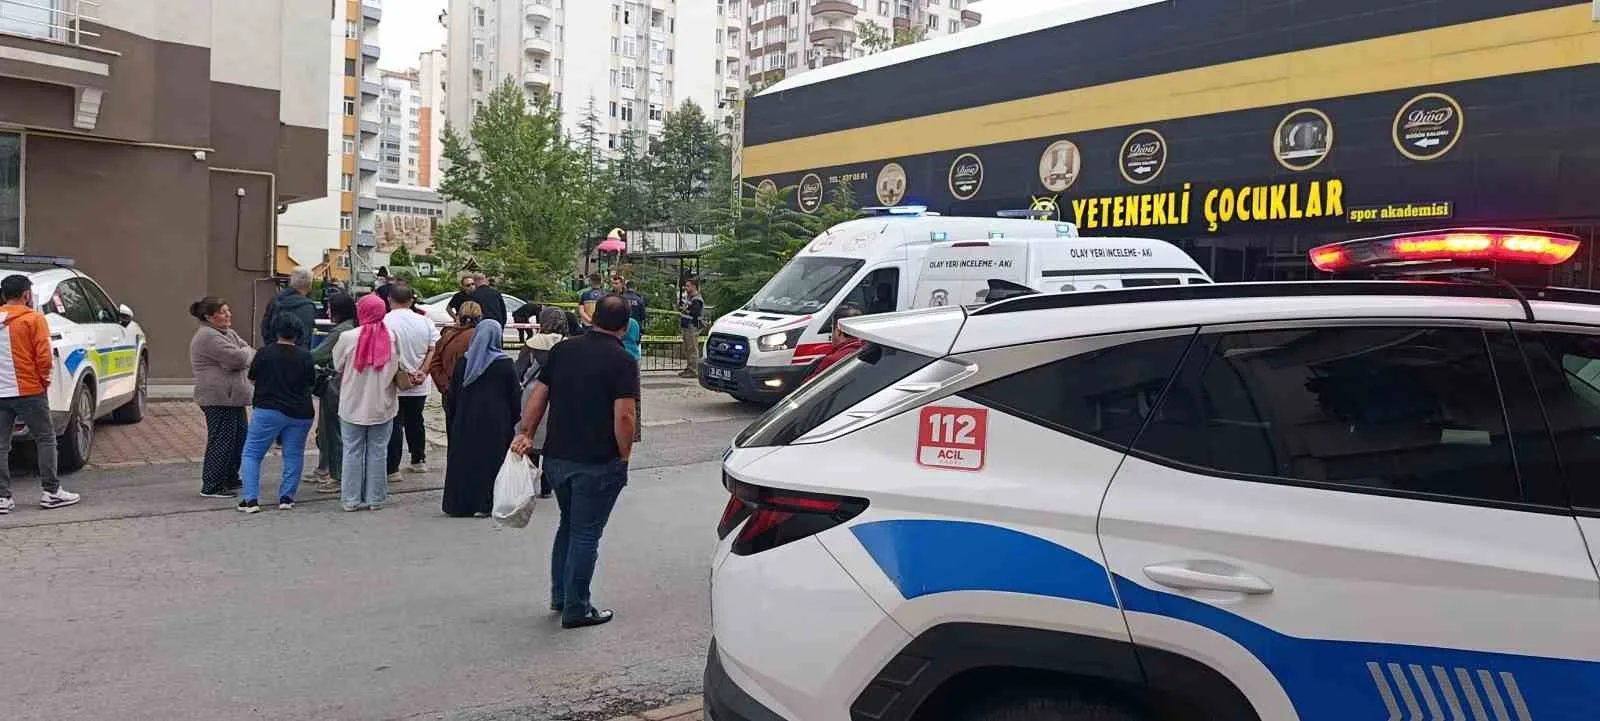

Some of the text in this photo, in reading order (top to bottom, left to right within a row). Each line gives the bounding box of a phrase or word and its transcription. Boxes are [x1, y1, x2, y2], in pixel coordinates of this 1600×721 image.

[1406, 107, 1452, 125] Diva
[1072, 179, 1344, 232] YETENEKLİ ÇOCUKLAR
[1350, 202, 1449, 222] spor akademisi
[1070, 248, 1088, 258] OLAY
[929, 260, 944, 269] OLAY
[929, 413, 977, 445] 112
[937, 449, 964, 460] ACİL
